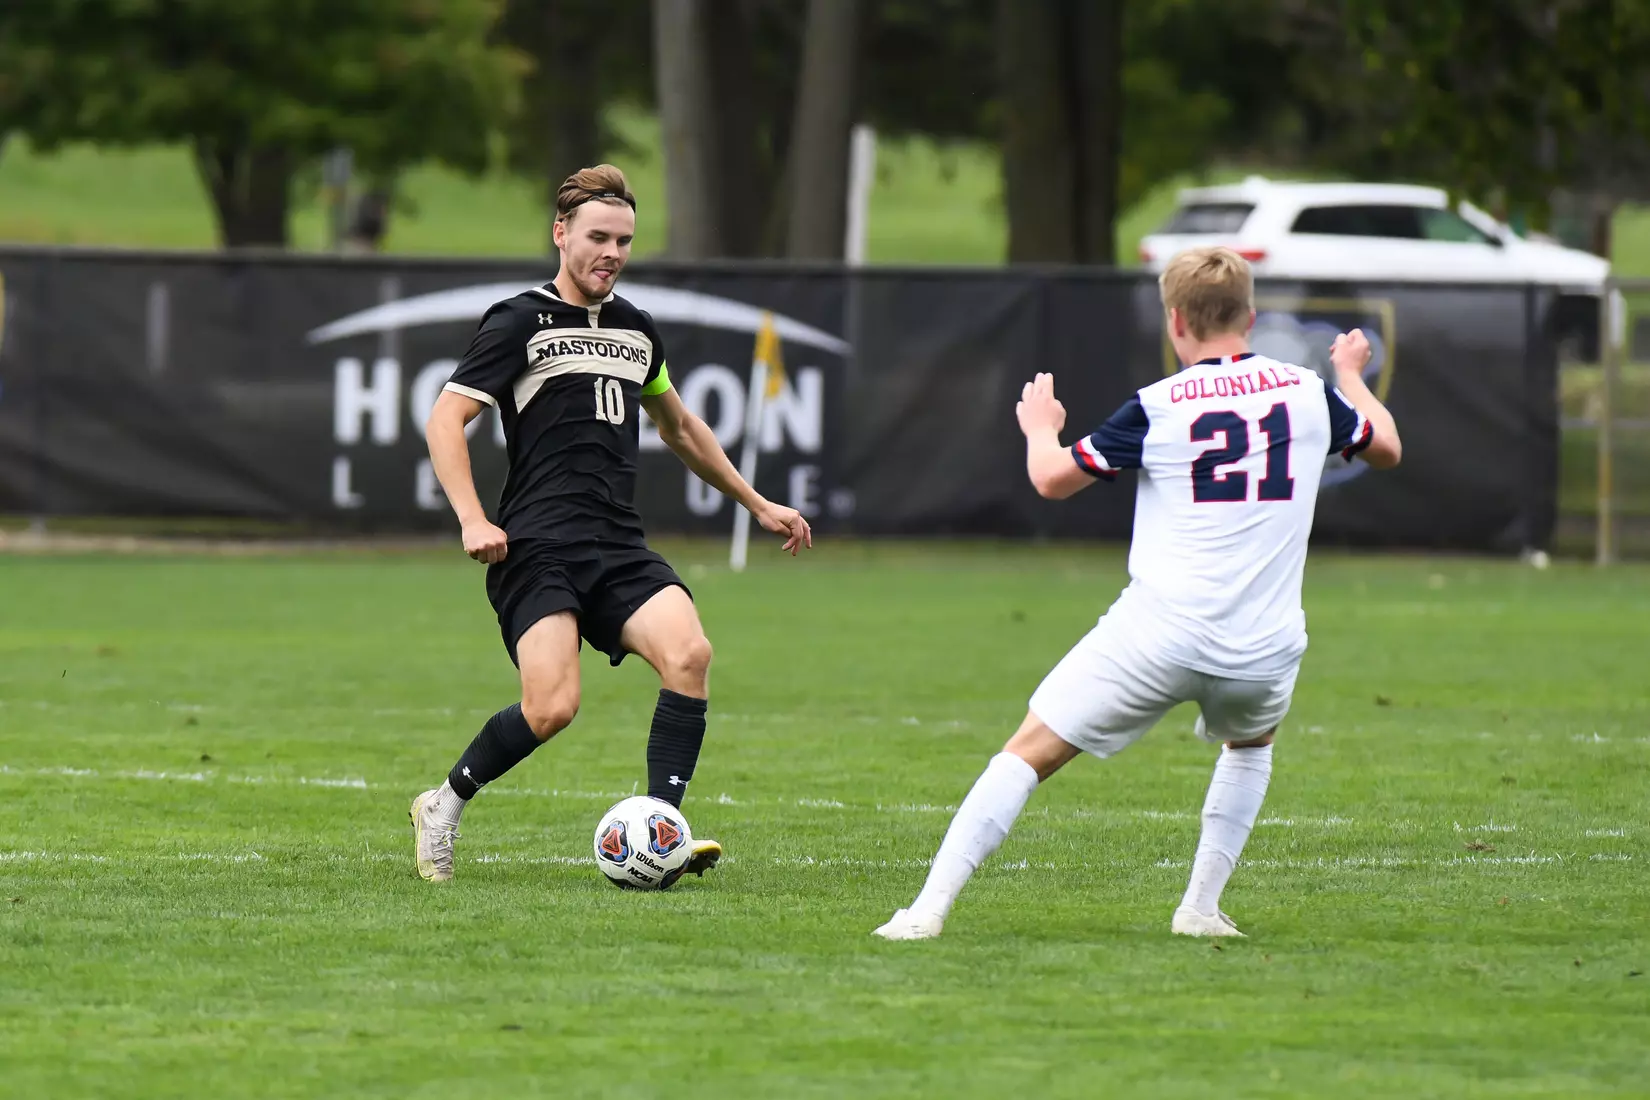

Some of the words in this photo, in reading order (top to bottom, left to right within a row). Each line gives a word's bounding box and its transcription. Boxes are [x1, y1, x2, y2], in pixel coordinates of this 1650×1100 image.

[536, 340, 648, 367] MASTODONS
[594, 377, 626, 425] 10
[1170, 367, 1301, 404] COLONIALS
[334, 356, 823, 454] HOON
[1190, 402, 1295, 503] 21
[627, 866, 654, 884] NCAA
[635, 851, 664, 873] Wilson
